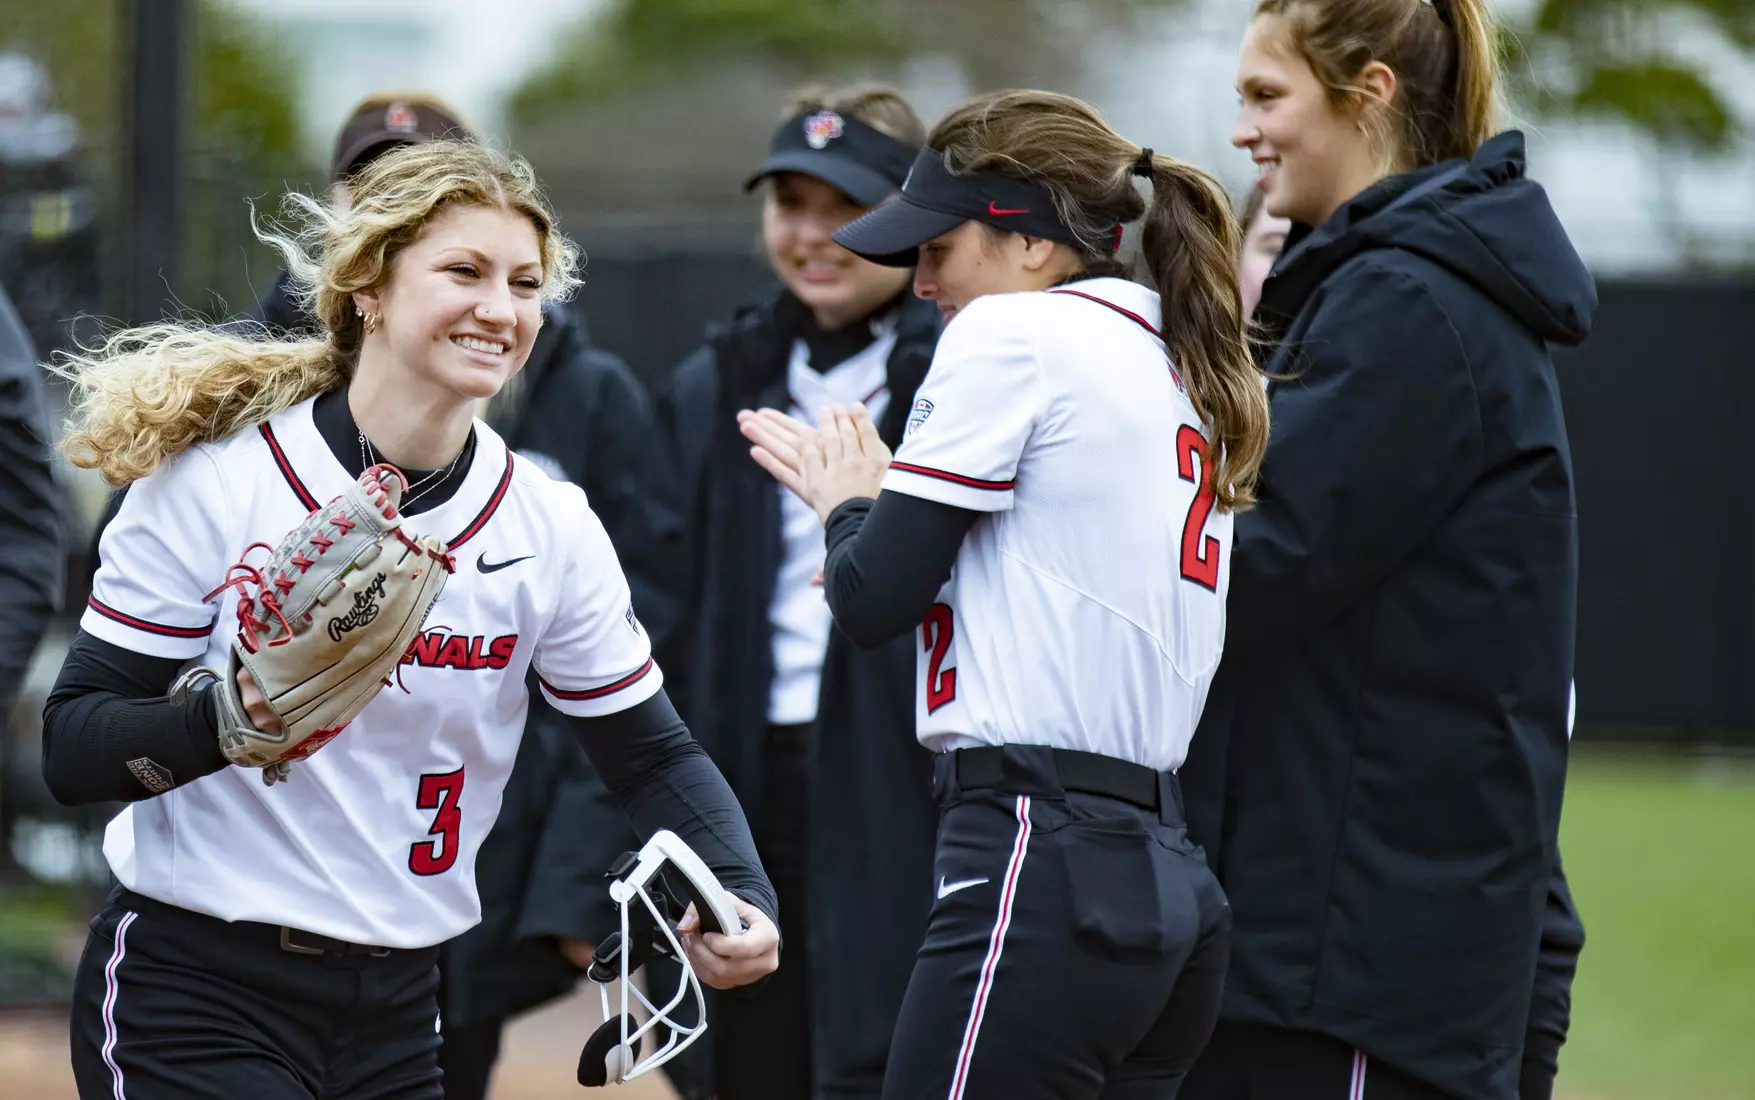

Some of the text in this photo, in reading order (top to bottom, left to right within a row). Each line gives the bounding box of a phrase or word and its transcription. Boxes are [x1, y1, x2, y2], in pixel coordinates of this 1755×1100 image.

[1176, 423, 1220, 594] 2
[328, 572, 386, 642] Rawlings
[923, 602, 956, 716] 2
[134, 761, 167, 790] ZONE
[408, 764, 465, 876] 3
